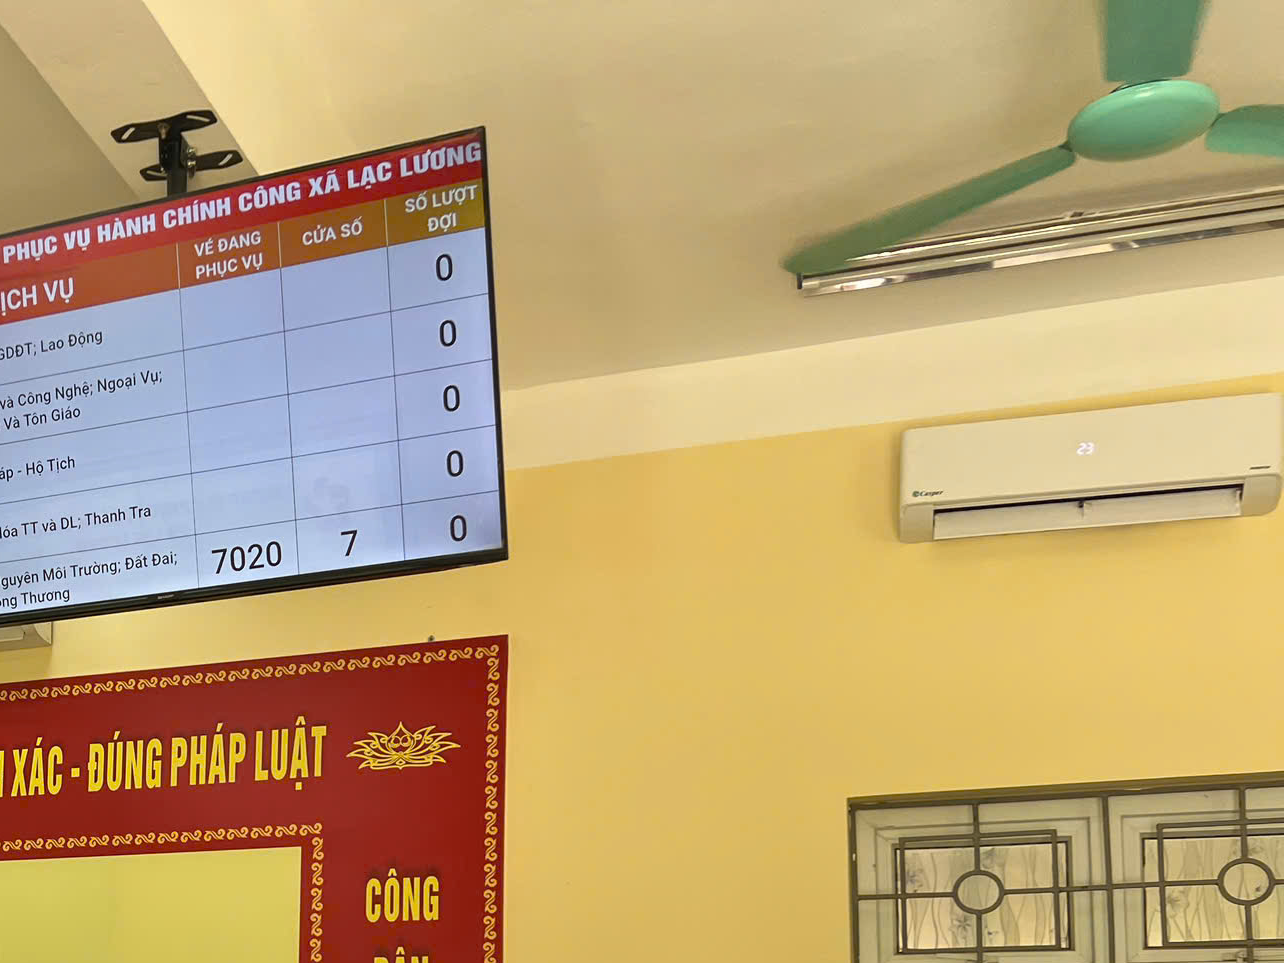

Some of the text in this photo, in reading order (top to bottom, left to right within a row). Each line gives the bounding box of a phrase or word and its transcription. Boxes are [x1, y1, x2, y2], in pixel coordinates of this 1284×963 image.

[3, 236, 57, 264] PHỤC
[63, 229, 90, 251] VỤ
[97, 213, 156, 244] HÀNH
[163, 196, 231, 229] CHÍNH
[238, 181, 301, 213] CÔNG
[308, 170, 340, 198] XÃ
[347, 161, 392, 190] LẠC
[399, 142, 482, 178] LƯƠNG
[405, 184, 478, 214] SỐ LƯỢT
[302, 223, 336, 247] CỬA
[427, 212, 457, 233] ĐỢI
[194, 230, 262, 257] VÉ ĐANG
[195, 253, 263, 280] PHỤC VỤ
[435, 254, 453, 281] 0
[43, 277, 75, 303] VỤ
[40, 338, 64, 353] Lao
[68, 330, 103, 349] Động
[439, 320, 457, 347] 0
[0, 395, 14, 410] và
[17, 389, 51, 409] Công
[55, 382, 93, 403] Nghệ;
[97, 372, 136, 394] Ngoại
[140, 369, 163, 386] Vụ;
[443, 385, 460, 412] 0
[4, 415, 20, 430] Và
[23, 410, 47, 428] Tôn
[51, 406, 81, 423] Giáo
[25, 460, 44, 477] Hộ
[47, 456, 75, 472] Tịch
[446, 450, 464, 477] 0
[21, 521, 38, 535] TT
[42, 517, 57, 532] và
[60, 515, 81, 531] DL;
[85, 508, 126, 527] Thanh
[129, 505, 151, 520] Tra
[449, 515, 467, 542] 0
[340, 529, 358, 556] 7
[43, 565, 66, 581] Môi
[70, 559, 121, 577] Trường;
[125, 554, 148, 570] Đất
[151, 552, 178, 567] Đai;
[211, 541, 282, 575] 7020
[21, 588, 70, 606] Thương
[11, 736, 63, 797] XÁC
[71, 767, 80, 778] -
[87, 730, 163, 793] ĐÚNG
[170, 722, 246, 786] PHÁP
[254, 715, 327, 790] LUẬT
[365, 868, 439, 922] CÔNG
